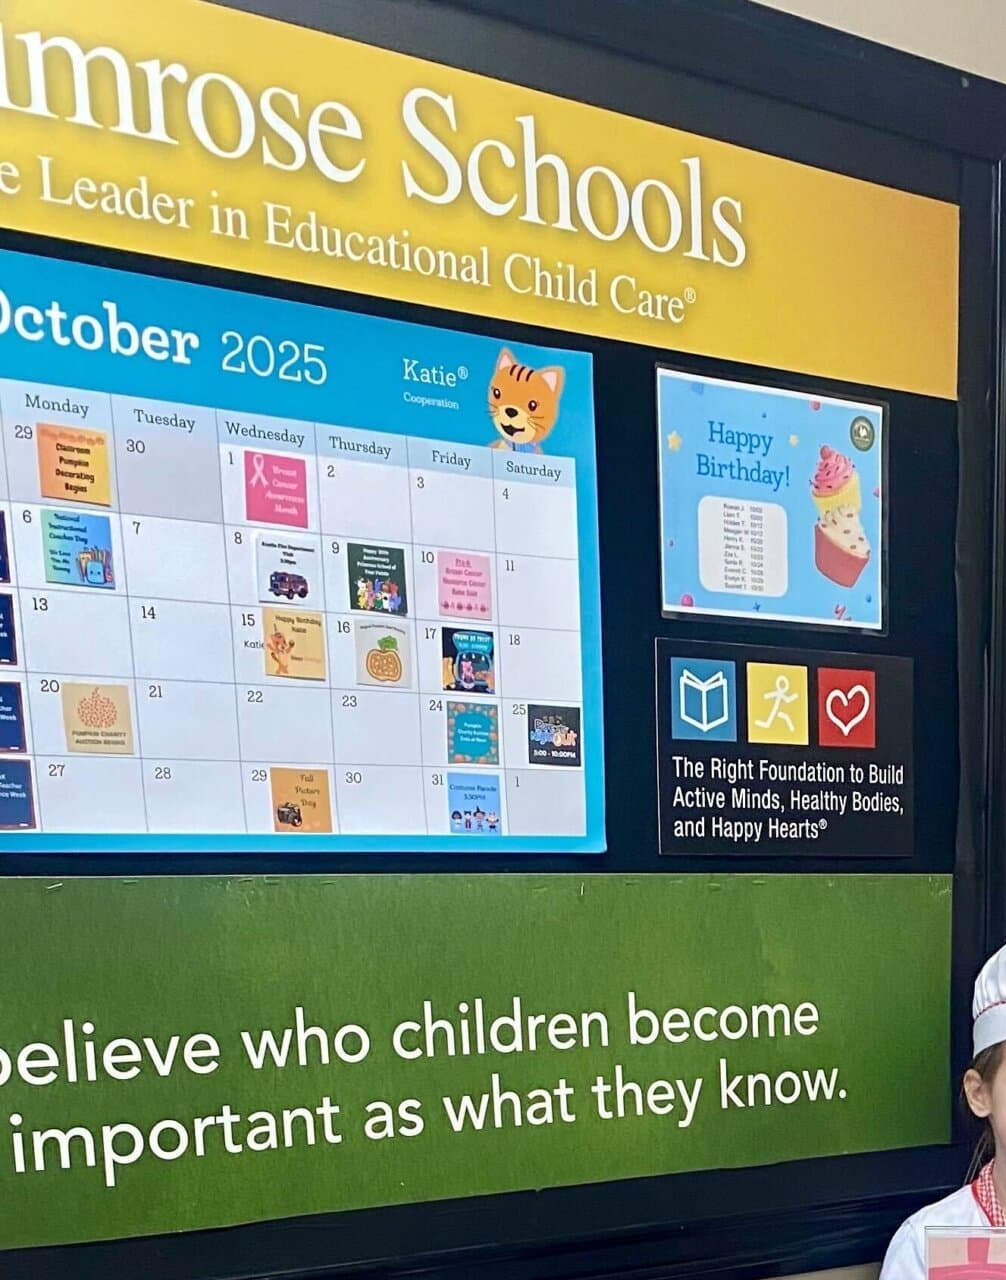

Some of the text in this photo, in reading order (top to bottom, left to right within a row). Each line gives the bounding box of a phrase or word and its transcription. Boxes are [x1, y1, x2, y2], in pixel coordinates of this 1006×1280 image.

[402, 86, 748, 268] Schools
[38, 155, 193, 229] Leader
[210, 189, 250, 242] in
[265, 201, 491, 288] Educational
[504, 252, 599, 308] Child
[221, 331, 329, 386] 2025
[403, 391, 460, 411] Cooperation
[14, 424, 33, 440] 29
[25, 393, 562, 482] Monday Tuesday Wednesday Thursday Friday Saturday
[707, 420, 774, 456] Happy
[126, 439, 146, 454] 30
[228, 451, 235, 466] 1
[327, 465, 336, 478] 2
[696, 453, 790, 492] Birthday!
[417, 476, 425, 489] 3
[502, 487, 510, 500] 4
[22, 510, 32, 523] 6
[132, 521, 140, 535] 7
[234, 531, 243, 545] 8
[331, 542, 340, 554] 9
[421, 551, 434, 564] 10
[505, 559, 515, 572] 11
[33, 597, 48, 611] 13
[141, 605, 156, 619] 14
[241, 613, 255, 627] 15
[337, 620, 350, 634] 16
[424, 627, 436, 640] 17
[508, 634, 521, 647] 18
[40, 679, 60, 693] 20
[149, 685, 163, 698] 21
[247, 690, 263, 703] 22
[342, 695, 357, 707] 23
[429, 700, 443, 712] 24
[512, 704, 527, 715] 25
[48, 764, 65, 777] 27
[155, 767, 171, 780] 28
[251, 769, 267, 782] 29
[345, 771, 362, 784] 30
[672, 756, 904, 785] The Right Foundation to Build
[432, 775, 444, 787] 31
[515, 776, 520, 788] 1
[672, 786, 904, 815] Active Minds, Healthy Bodies,
[673, 816, 705, 838] and
[712, 816, 763, 842] Happy
[240, 1006, 371, 1071] who
[392, 996, 610, 1061] children
[627, 990, 820, 1045] become
[9, 1059, 848, 1188] important as what they know.
